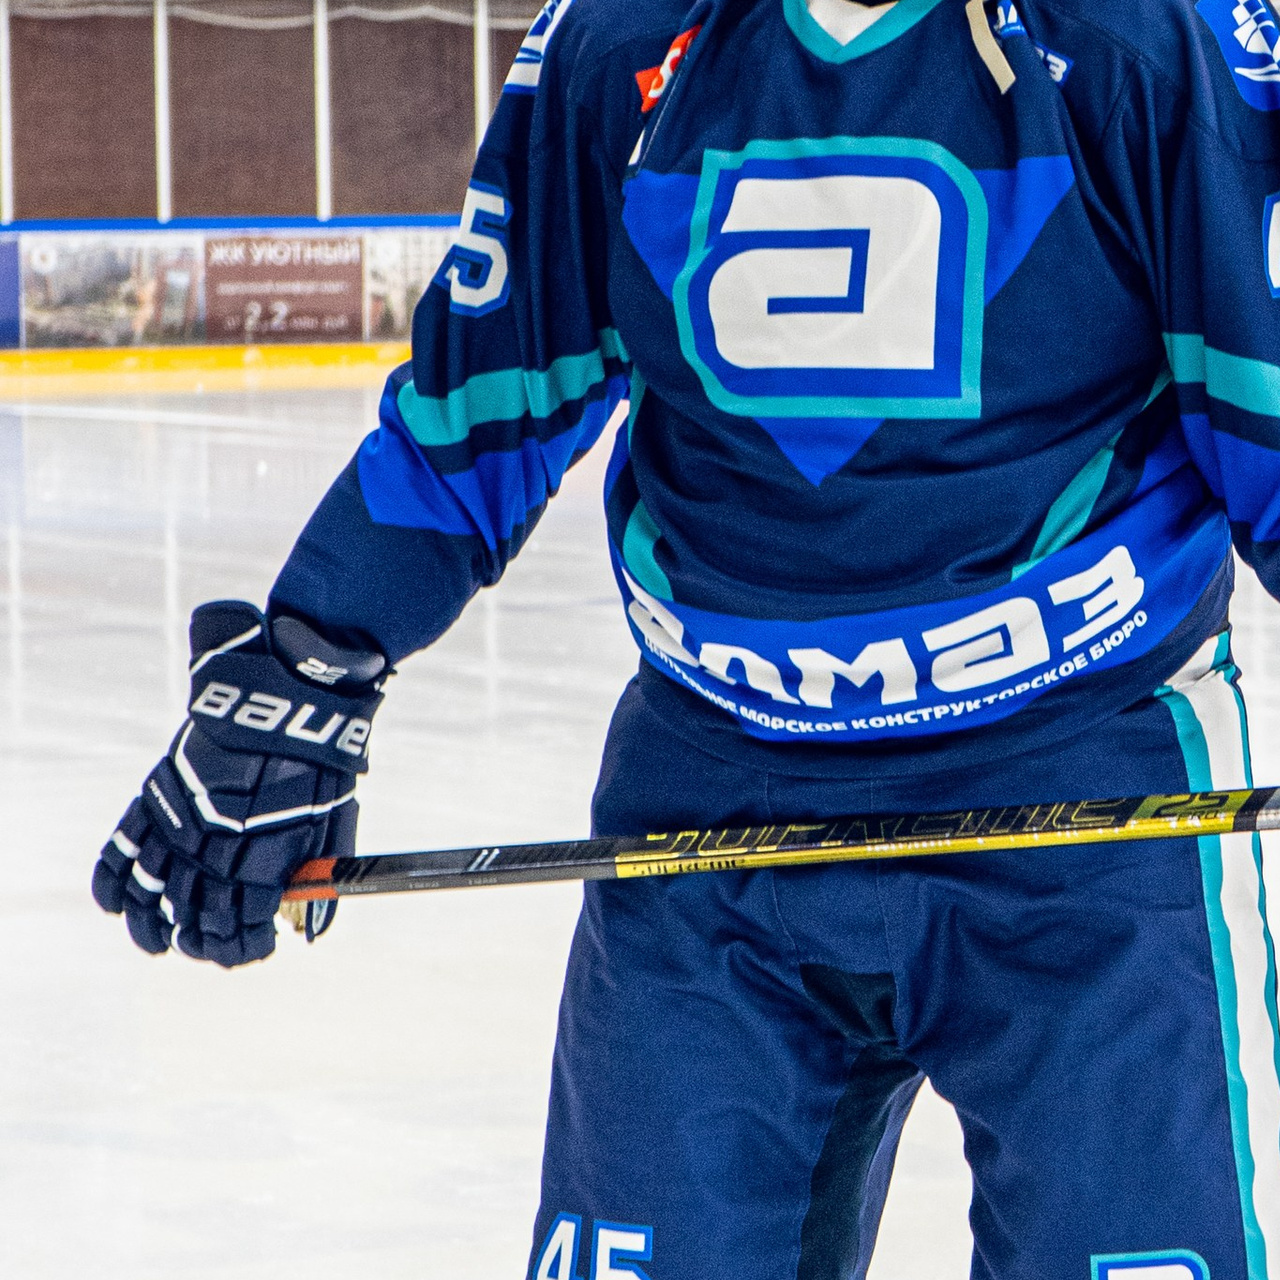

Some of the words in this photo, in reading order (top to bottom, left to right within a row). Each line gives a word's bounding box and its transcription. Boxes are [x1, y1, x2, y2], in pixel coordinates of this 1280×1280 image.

[444, 186, 509, 308] 5
[190, 681, 372, 760] BAUE
[740, 705, 848, 733] МОРСКОЕ
[851, 652, 1088, 730] КОНСТРУКТОРСКОЕ
[1090, 609, 1149, 662] БЮРО
